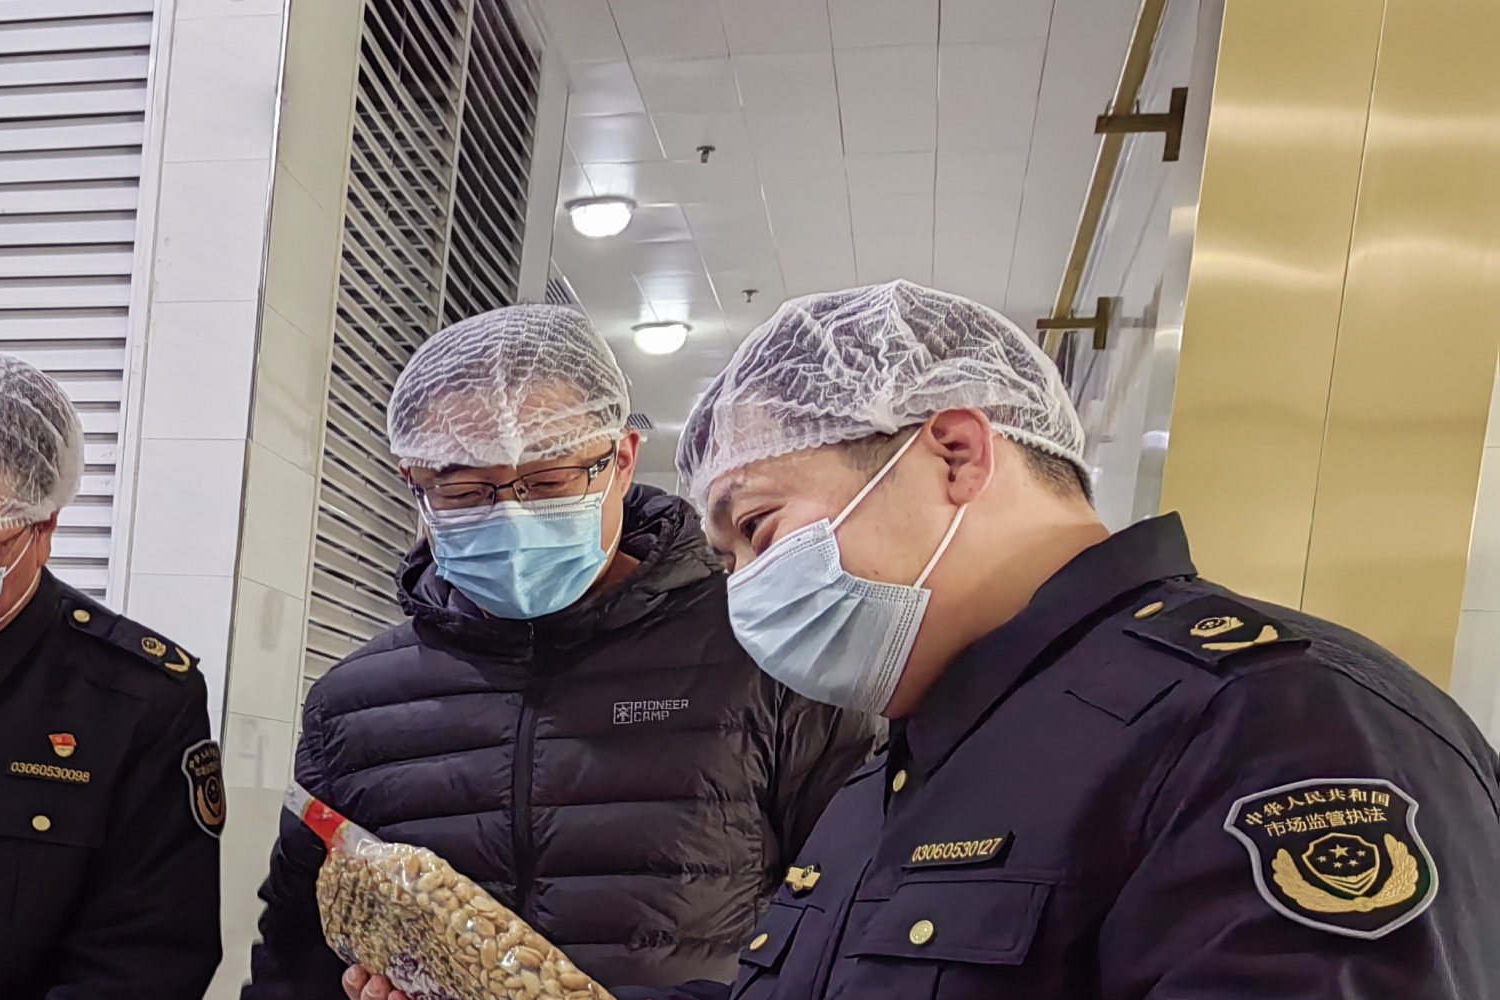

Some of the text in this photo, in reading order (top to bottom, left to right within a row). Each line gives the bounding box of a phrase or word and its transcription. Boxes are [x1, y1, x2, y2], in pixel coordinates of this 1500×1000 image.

[634, 699, 689, 711] PIONEER
[634, 711, 670, 722] CAMP
[1245, 787, 1391, 826] 中华人民共和国
[1264, 806, 1388, 838] 市场监管执法
[912, 837, 1003, 862] 03060530127
